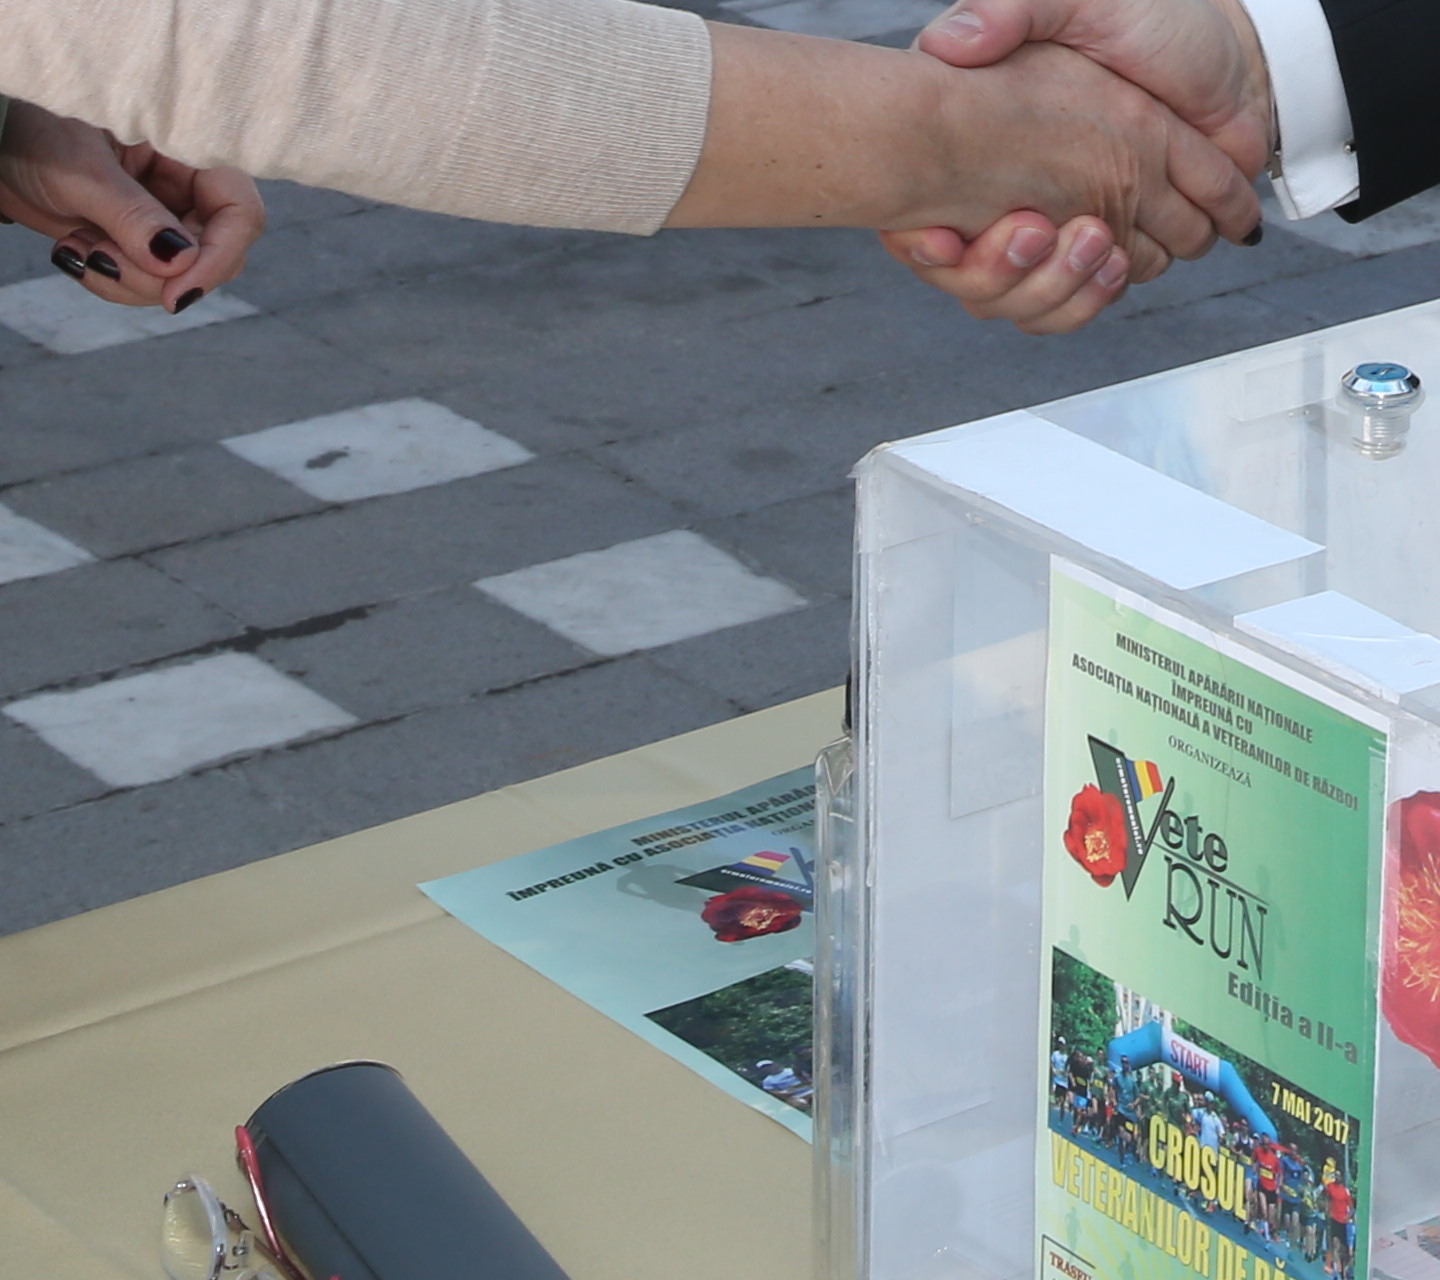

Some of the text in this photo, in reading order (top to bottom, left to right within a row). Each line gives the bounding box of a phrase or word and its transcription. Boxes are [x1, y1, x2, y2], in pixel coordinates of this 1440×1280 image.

[1072, 653, 1134, 696] ASOCIAȚIA
[1202, 722, 1212, 736] A
[1212, 725, 1292, 778] VETERANILOR
[1294, 769, 1310, 788] DE
[1313, 775, 1359, 811] RĂZBOI
[1115, 633, 1313, 744] MINISTERUL APĂRĂRII NAȚIONALE
[1171, 679, 1253, 735] ÎMPREUNĂ CU
[1168, 735, 1252, 788] ORGANIZEAZĂ
[505, 860, 615, 902] ÎMPREUNĂ
[613, 852, 643, 867] CU
[747, 798, 816, 837] NAȚION
[630, 810, 745, 847] MINISTERUL
[746, 784, 816, 817] APĂRĂ
[1162, 854, 1268, 980] RUN
[1170, 1039, 1210, 1081] START
[1227, 971, 1359, 1065] Ediția a II-a
[1271, 1082, 1350, 1145] 7 MAI 2017
[1051, 1130, 1249, 1280] VETERANILOR DE
[1149, 1114, 1247, 1221] CROSUL
